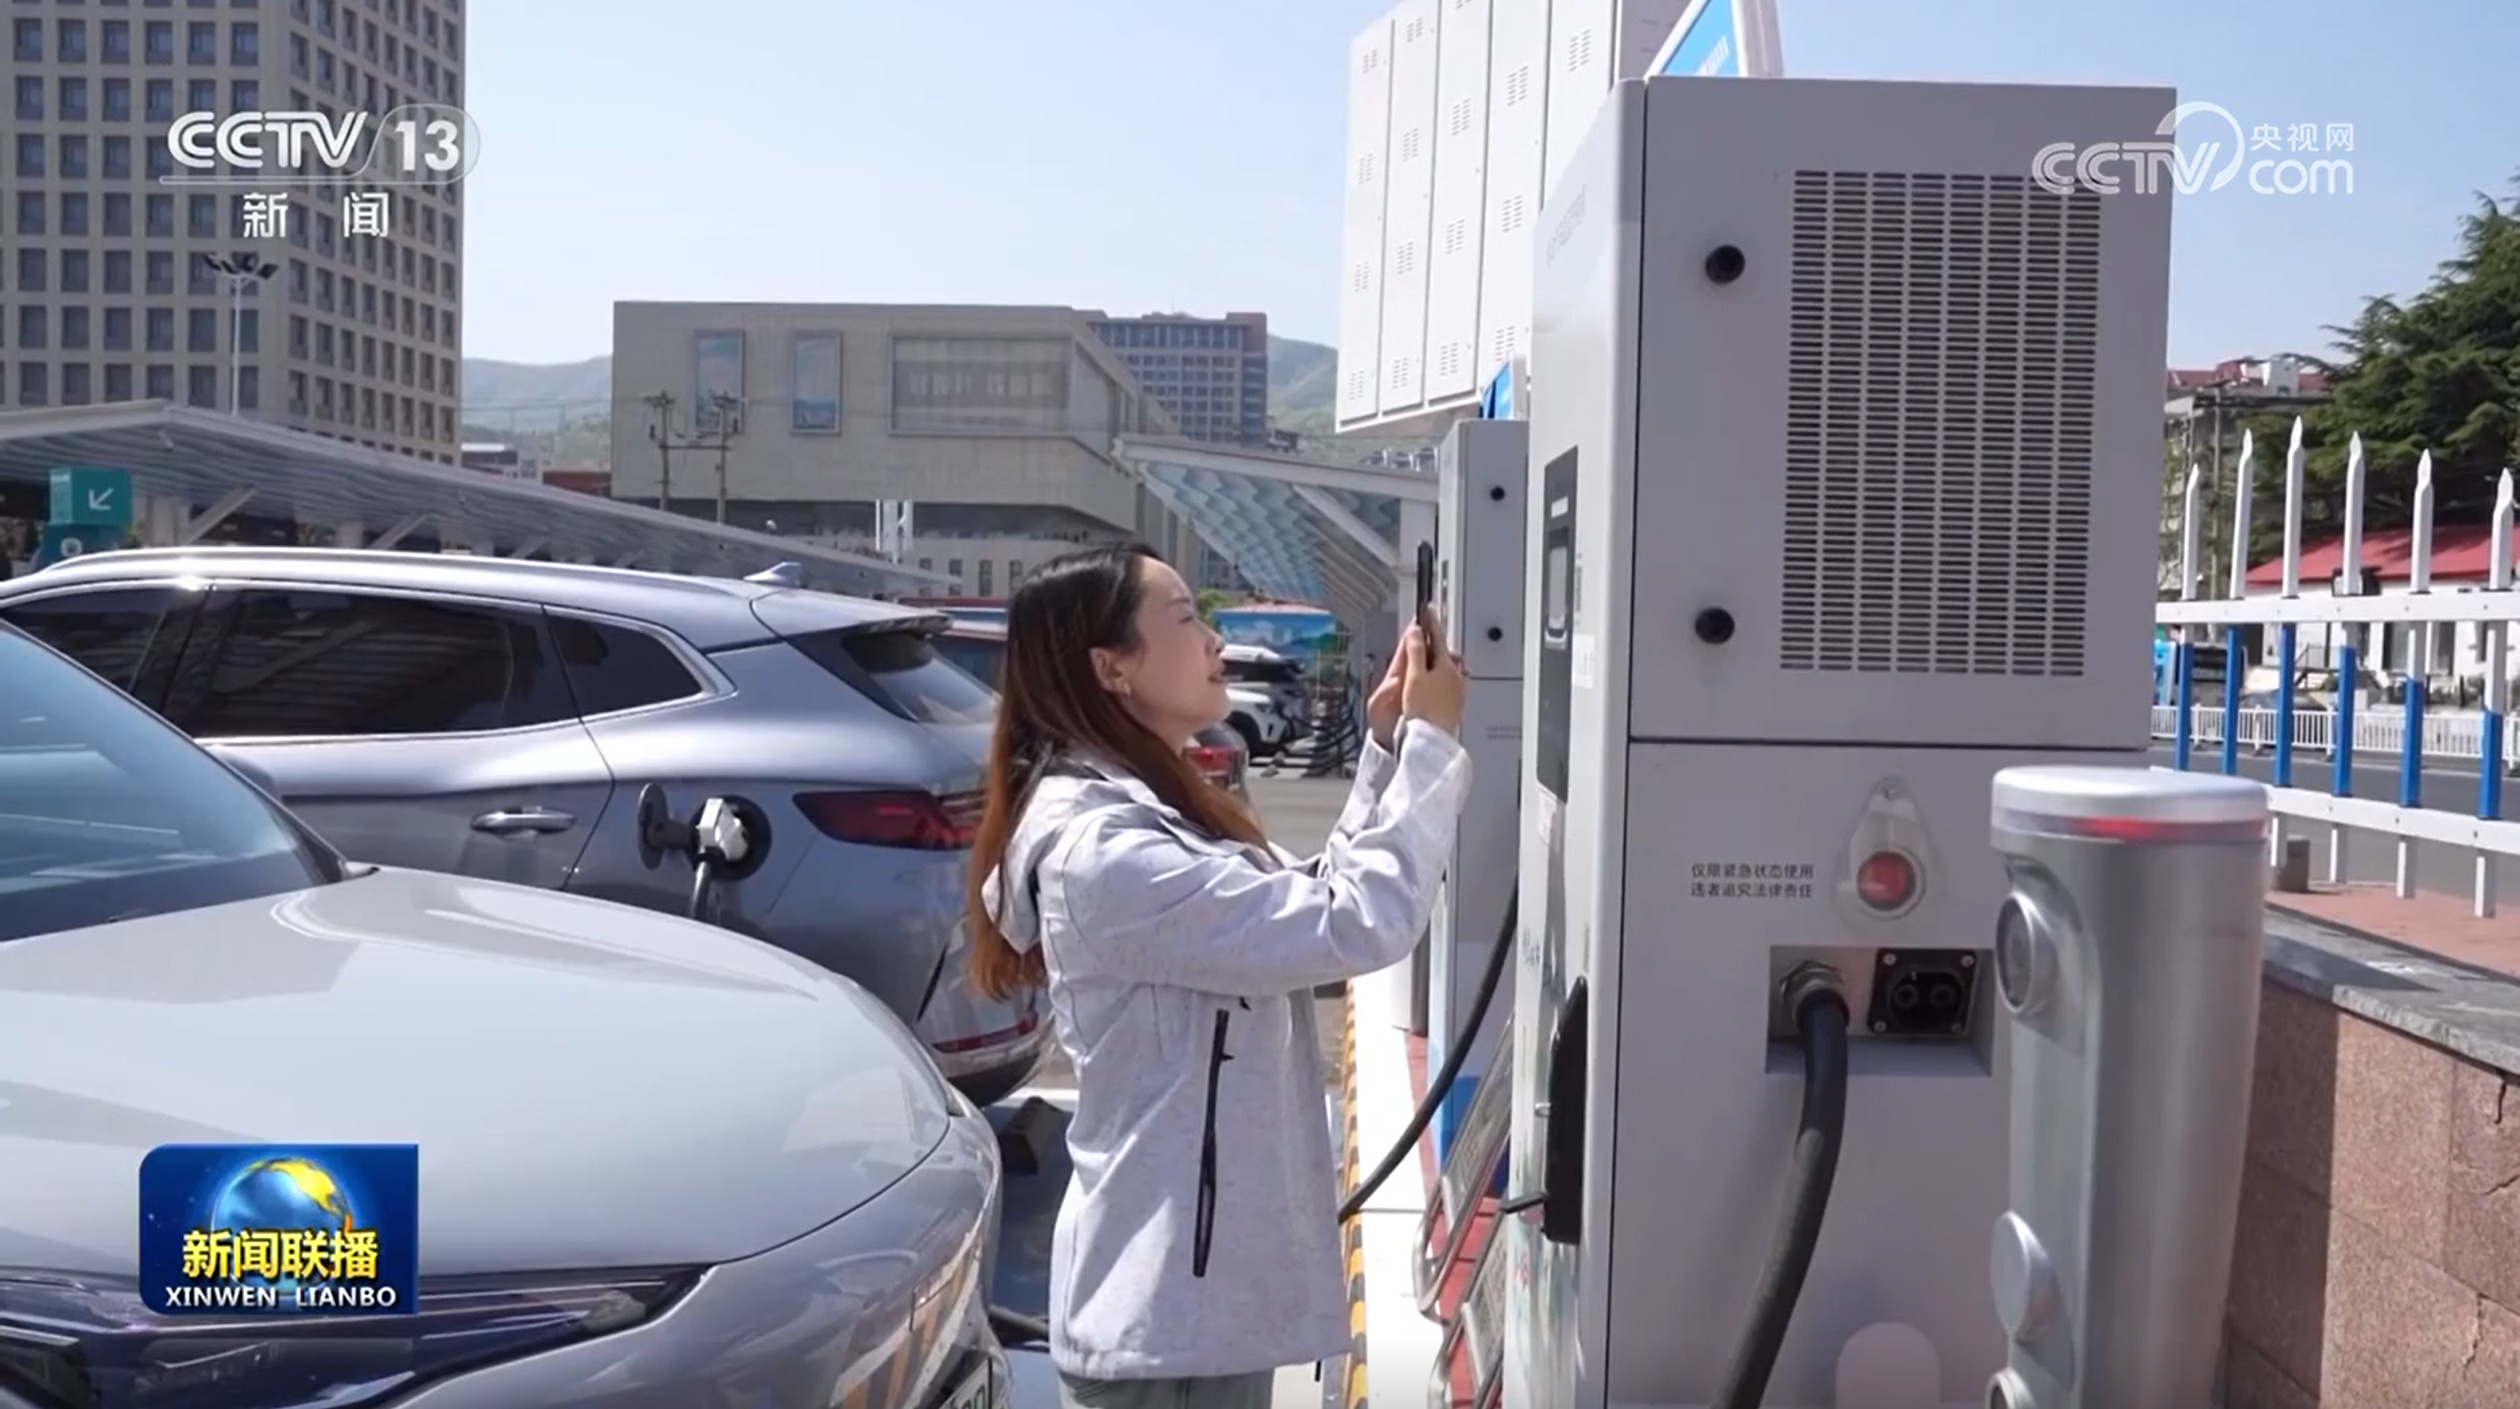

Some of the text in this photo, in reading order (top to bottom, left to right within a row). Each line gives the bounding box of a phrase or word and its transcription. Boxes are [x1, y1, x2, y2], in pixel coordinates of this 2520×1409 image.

[1691, 862, 1814, 880] 仅限紧急状态使用
[1690, 881, 1813, 899] 违者追究法律责任
